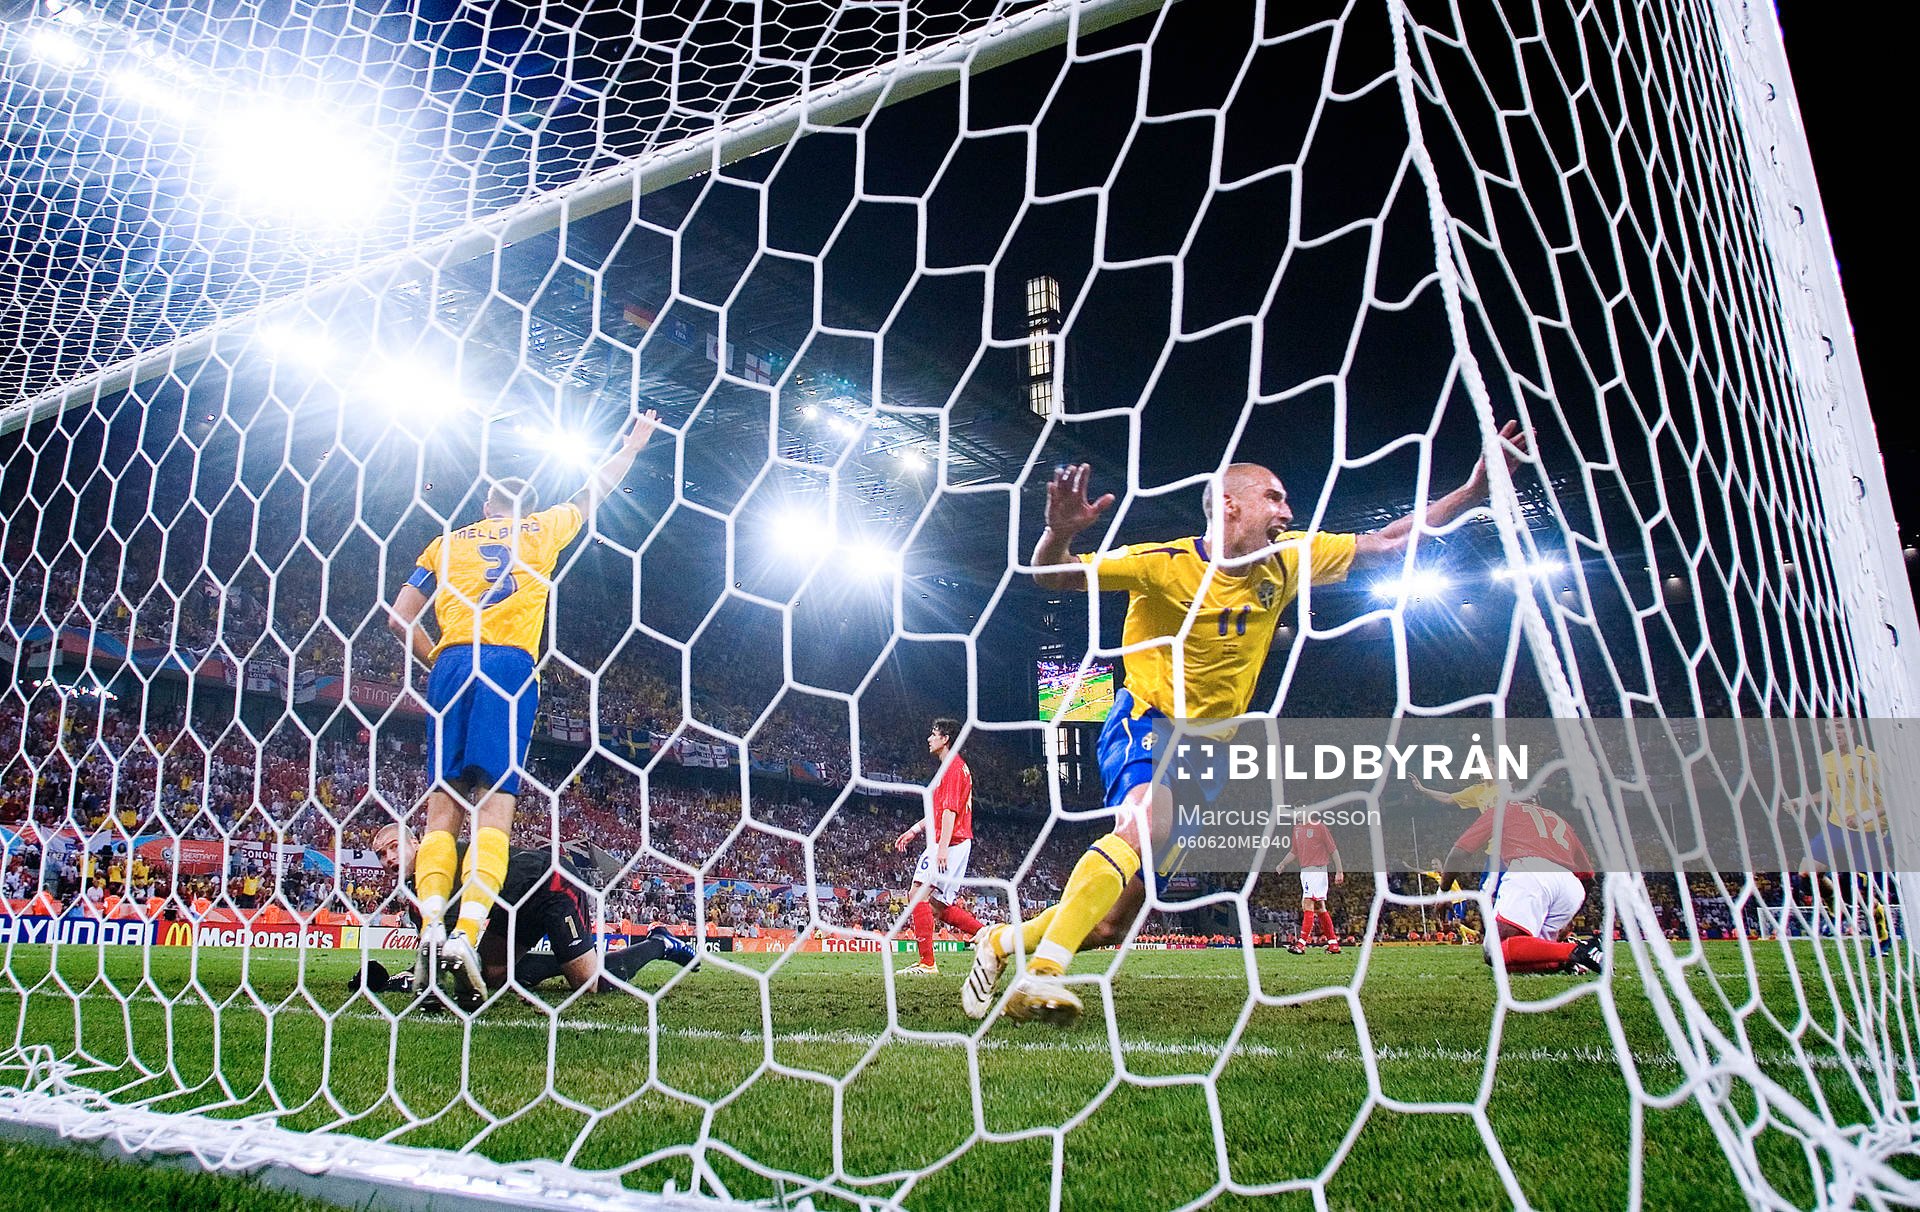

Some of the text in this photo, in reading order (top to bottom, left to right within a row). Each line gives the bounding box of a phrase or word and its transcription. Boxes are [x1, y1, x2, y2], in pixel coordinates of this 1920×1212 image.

[454, 522, 541, 540] MELLBRG
[477, 543, 519, 609] 3
[1218, 605, 1251, 636] 11
[920, 855, 929, 870] 6
[0, 918, 154, 945] HYUNDAI
[200, 927, 333, 948] McDonad's
[565, 915, 579, 939] 1
